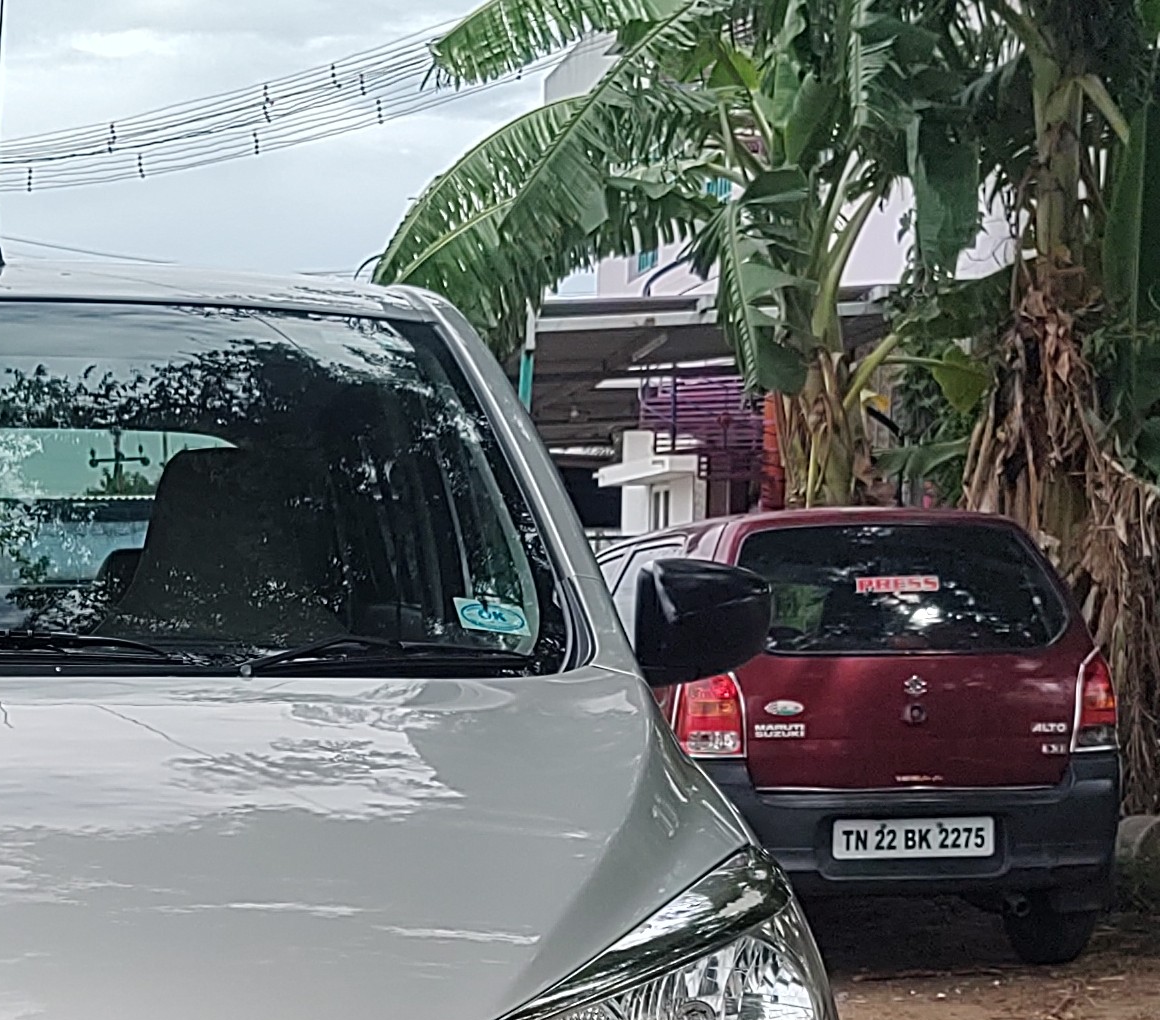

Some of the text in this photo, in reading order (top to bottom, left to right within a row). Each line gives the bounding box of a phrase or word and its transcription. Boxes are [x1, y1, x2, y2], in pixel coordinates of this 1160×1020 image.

[857, 577, 938, 592] PRESS
[478, 609, 507, 622] OK
[754, 723, 806, 732] MARUTI
[1031, 722, 1068, 733] ALTO
[754, 730, 806, 739] SUZUKI
[842, 827, 985, 851] TN 22 BK 2275
